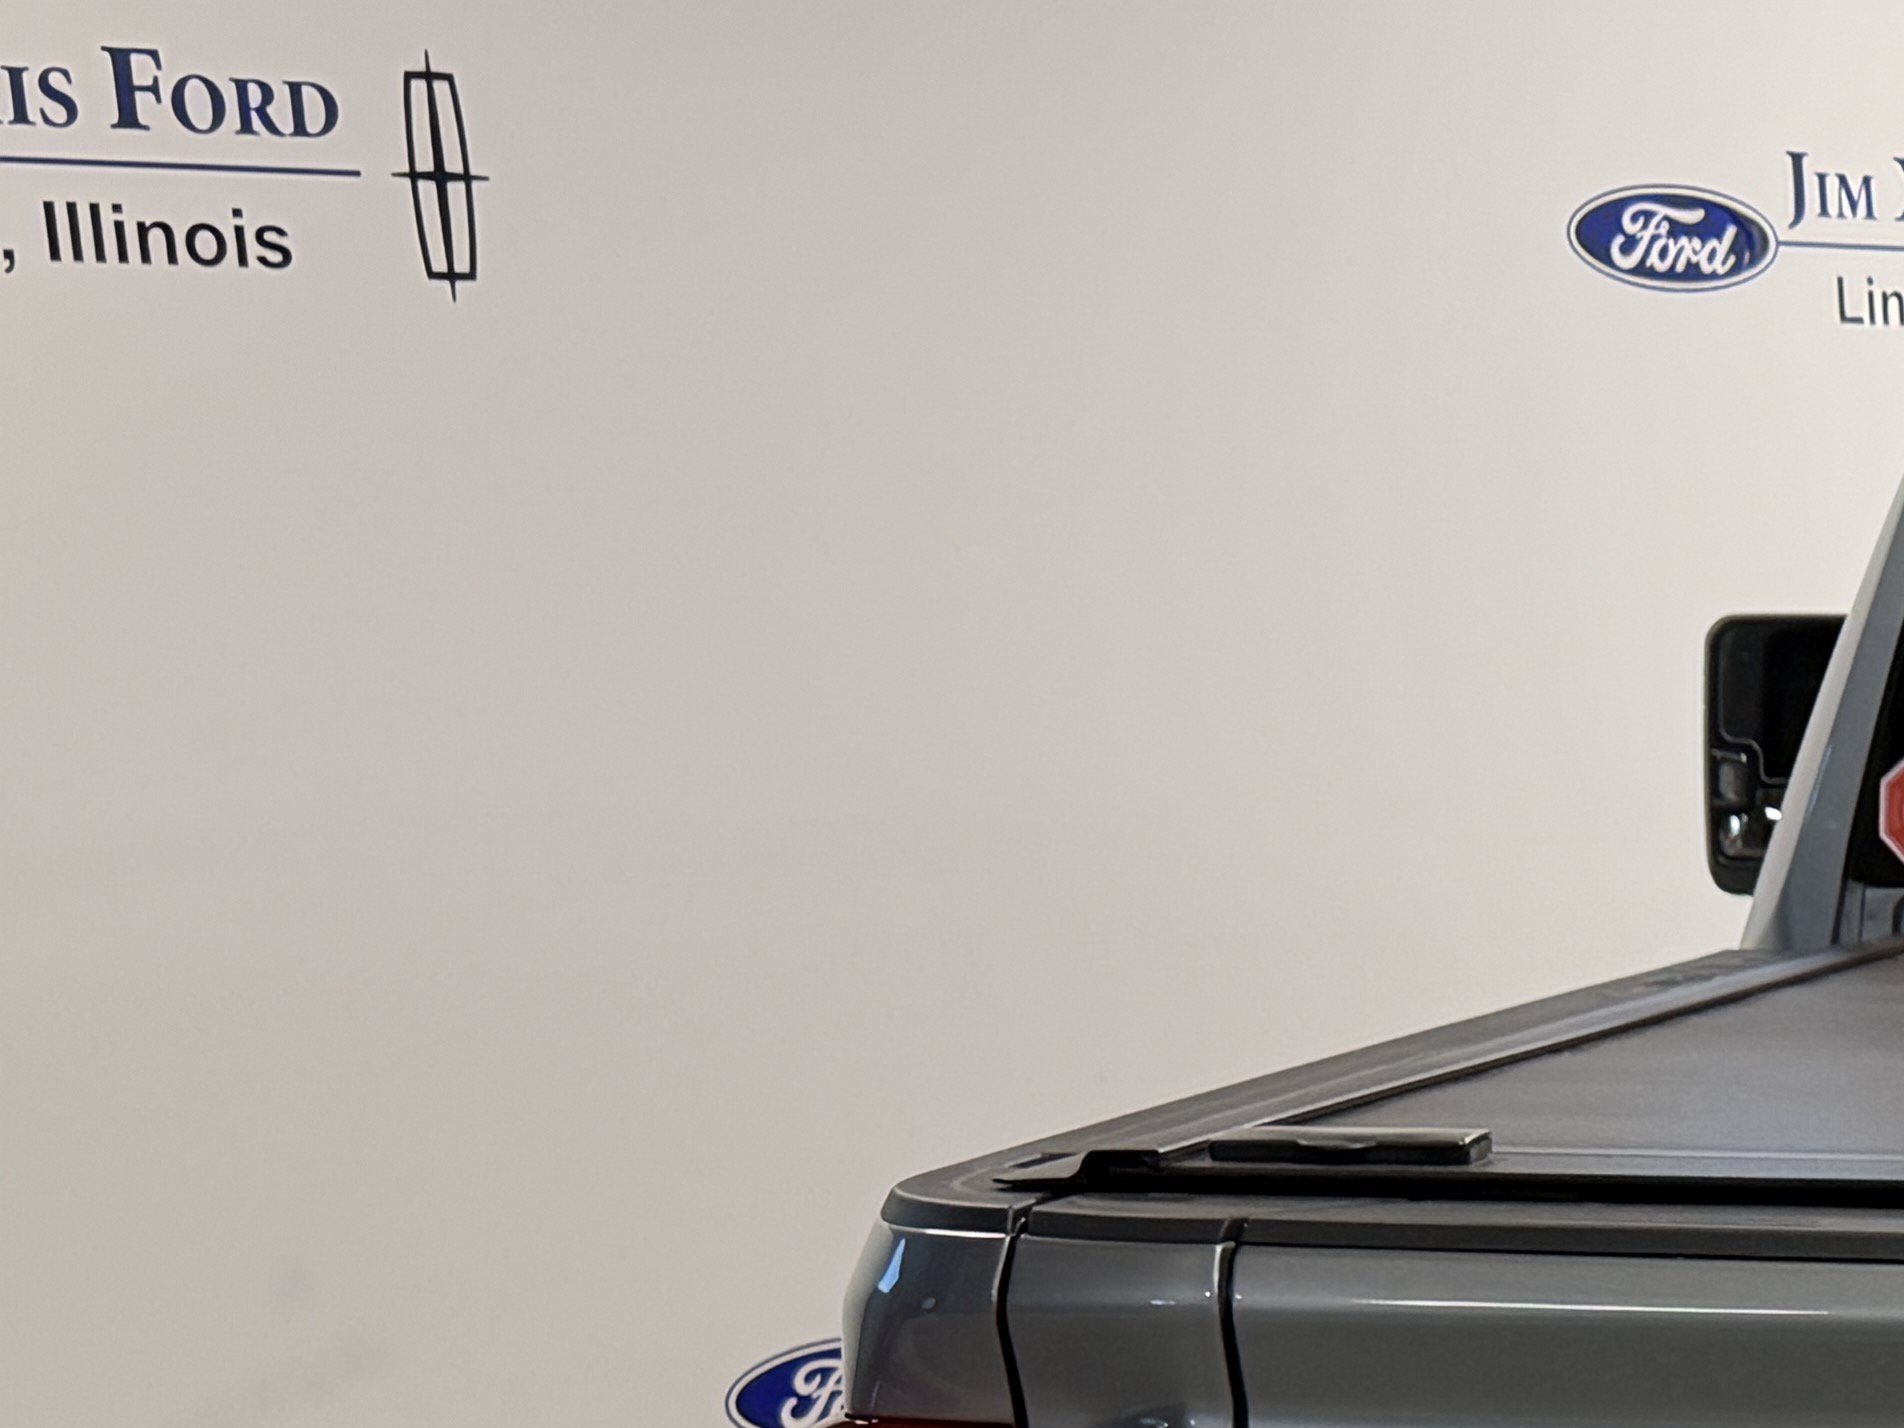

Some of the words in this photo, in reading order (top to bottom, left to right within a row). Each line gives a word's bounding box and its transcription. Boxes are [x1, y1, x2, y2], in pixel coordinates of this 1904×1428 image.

[100, 45, 339, 137] FORD
[1786, 151, 1876, 229] JIM
[42, 201, 293, 269] Illinois
[1610, 202, 1738, 275] Ford
